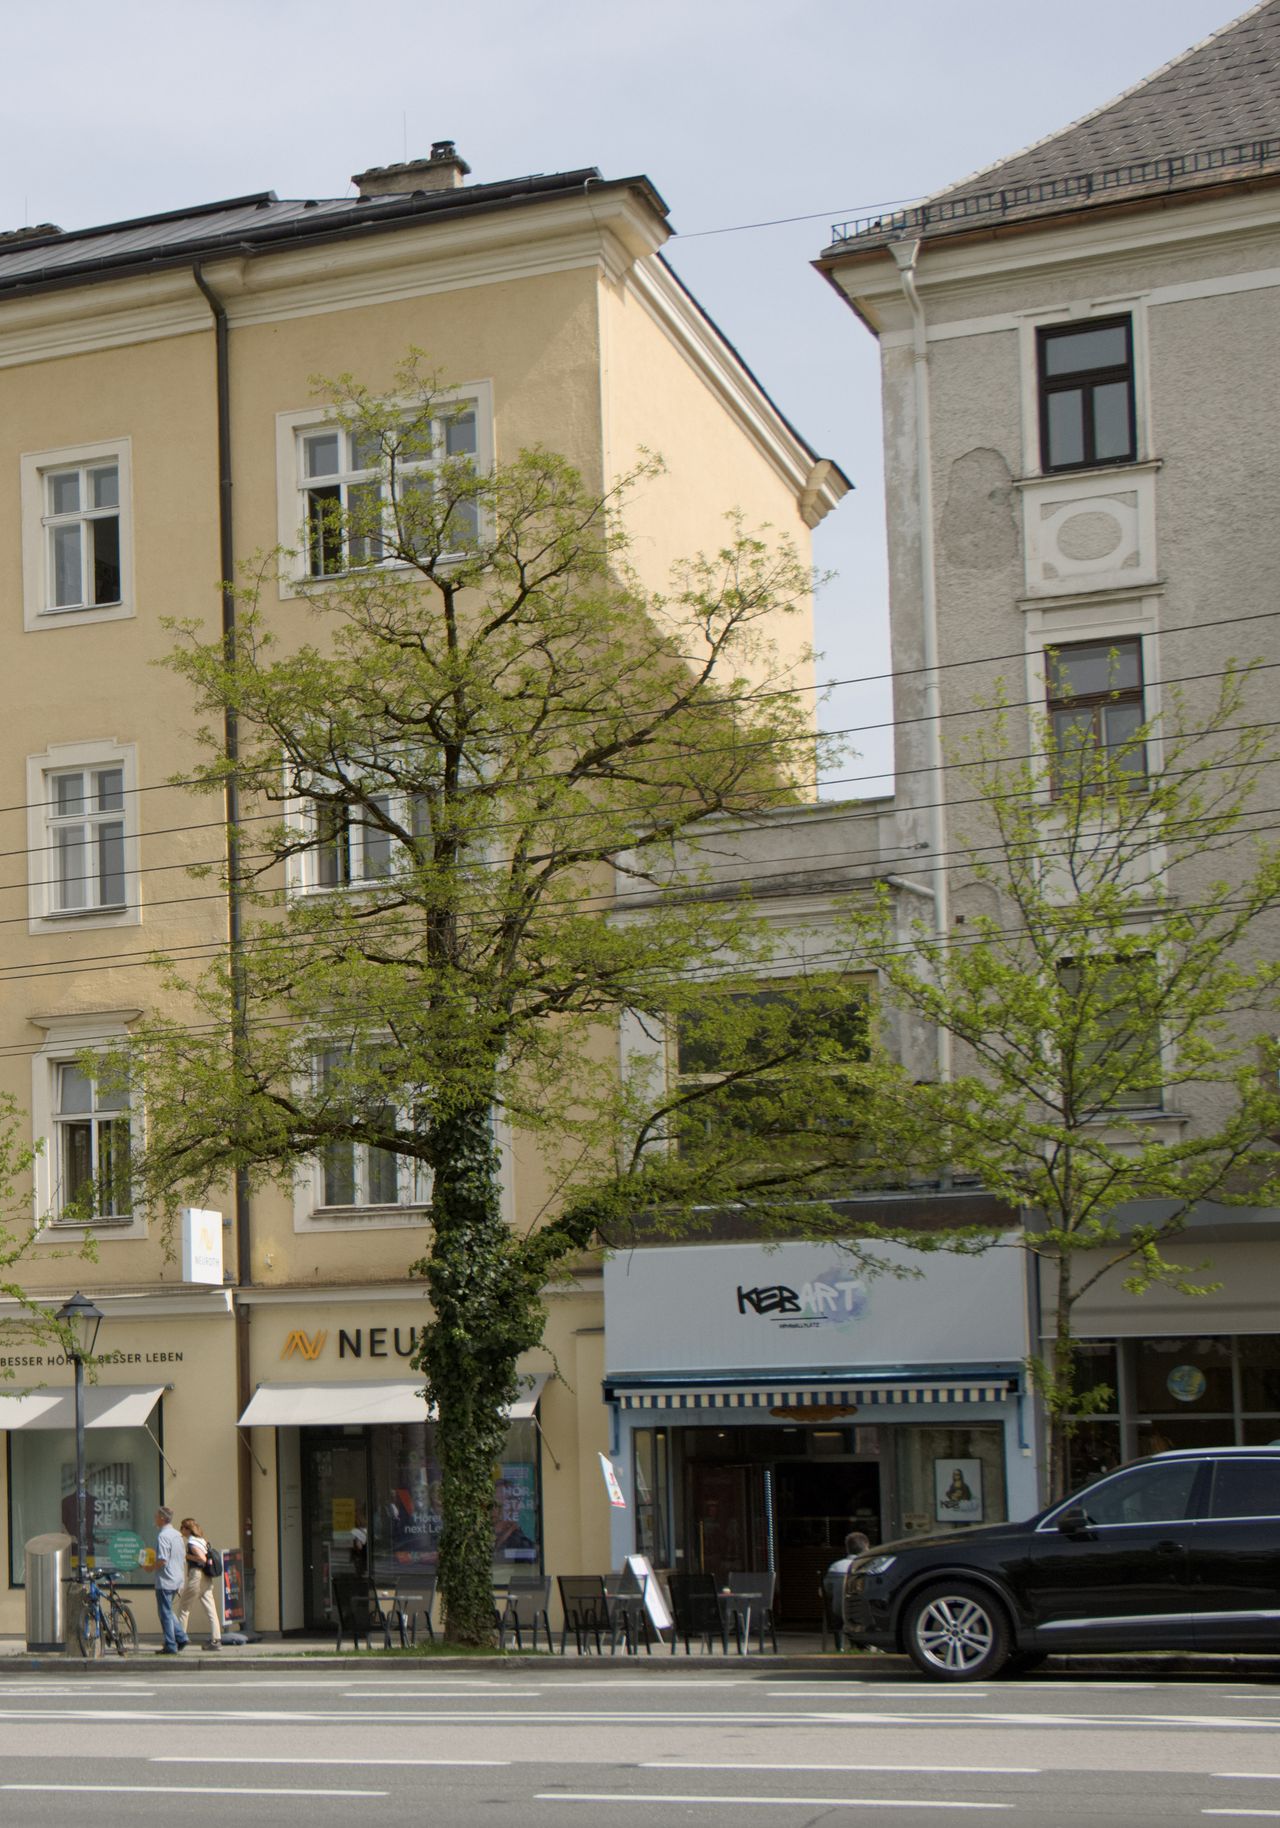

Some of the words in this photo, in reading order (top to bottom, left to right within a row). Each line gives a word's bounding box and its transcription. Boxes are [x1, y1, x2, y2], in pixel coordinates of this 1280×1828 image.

[338, 1327, 416, 1359] NEU
[0, 1356, 43, 1366] BESSER
[146, 1352, 183, 1362] LEBEN
[94, 1481, 125, 1497] HÖR
[94, 1497, 128, 1512] STÄR
[94, 1514, 112, 1526] KE
[404, 1524, 426, 1534] next
